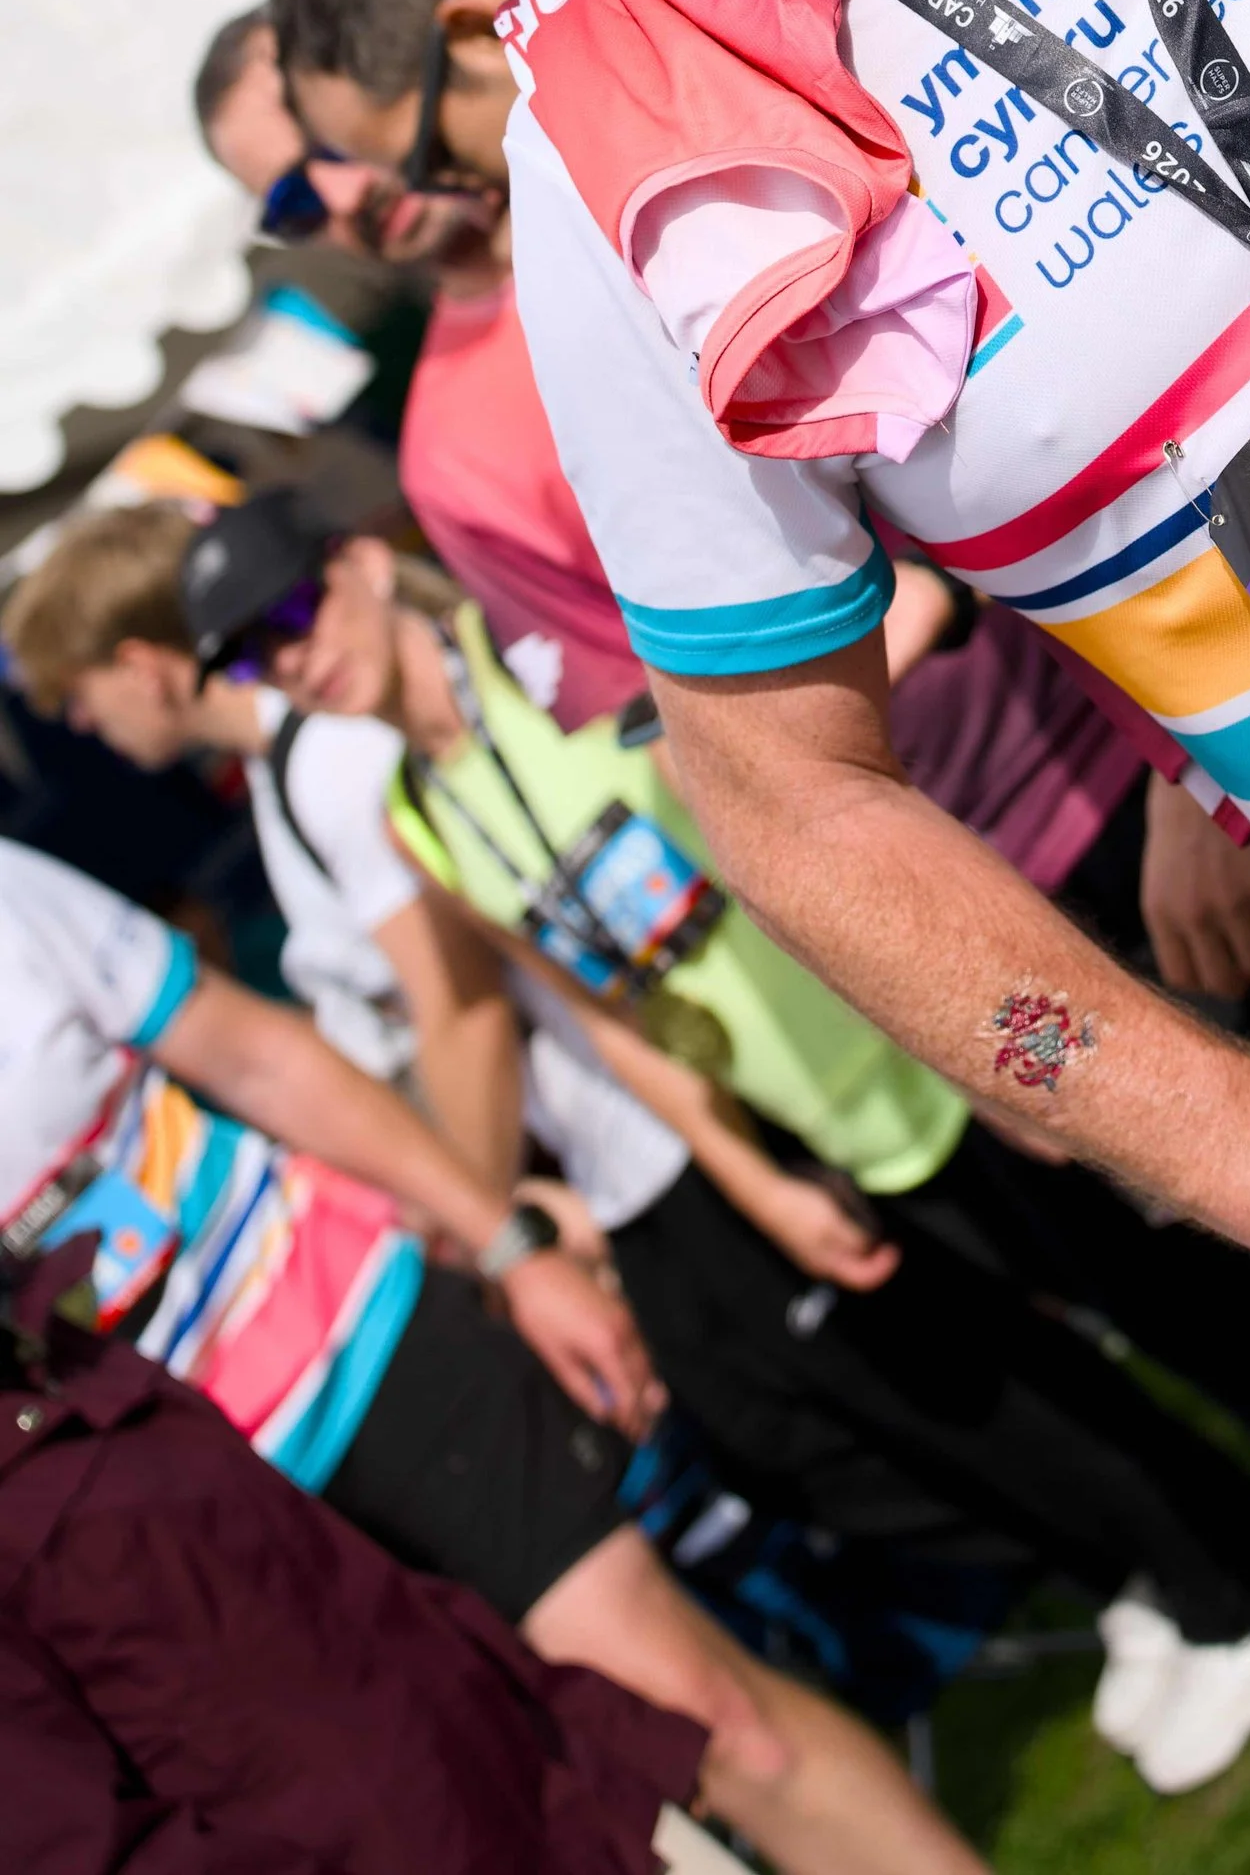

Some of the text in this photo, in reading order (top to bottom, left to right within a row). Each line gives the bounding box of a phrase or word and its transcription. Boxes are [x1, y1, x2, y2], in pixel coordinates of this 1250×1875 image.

[1208, 69, 1226, 95] HALFS
[1212, 64, 1232, 92] SUPER
[1070, 91, 1093, 110] SUPER
[994, 38, 1170, 234] caner
